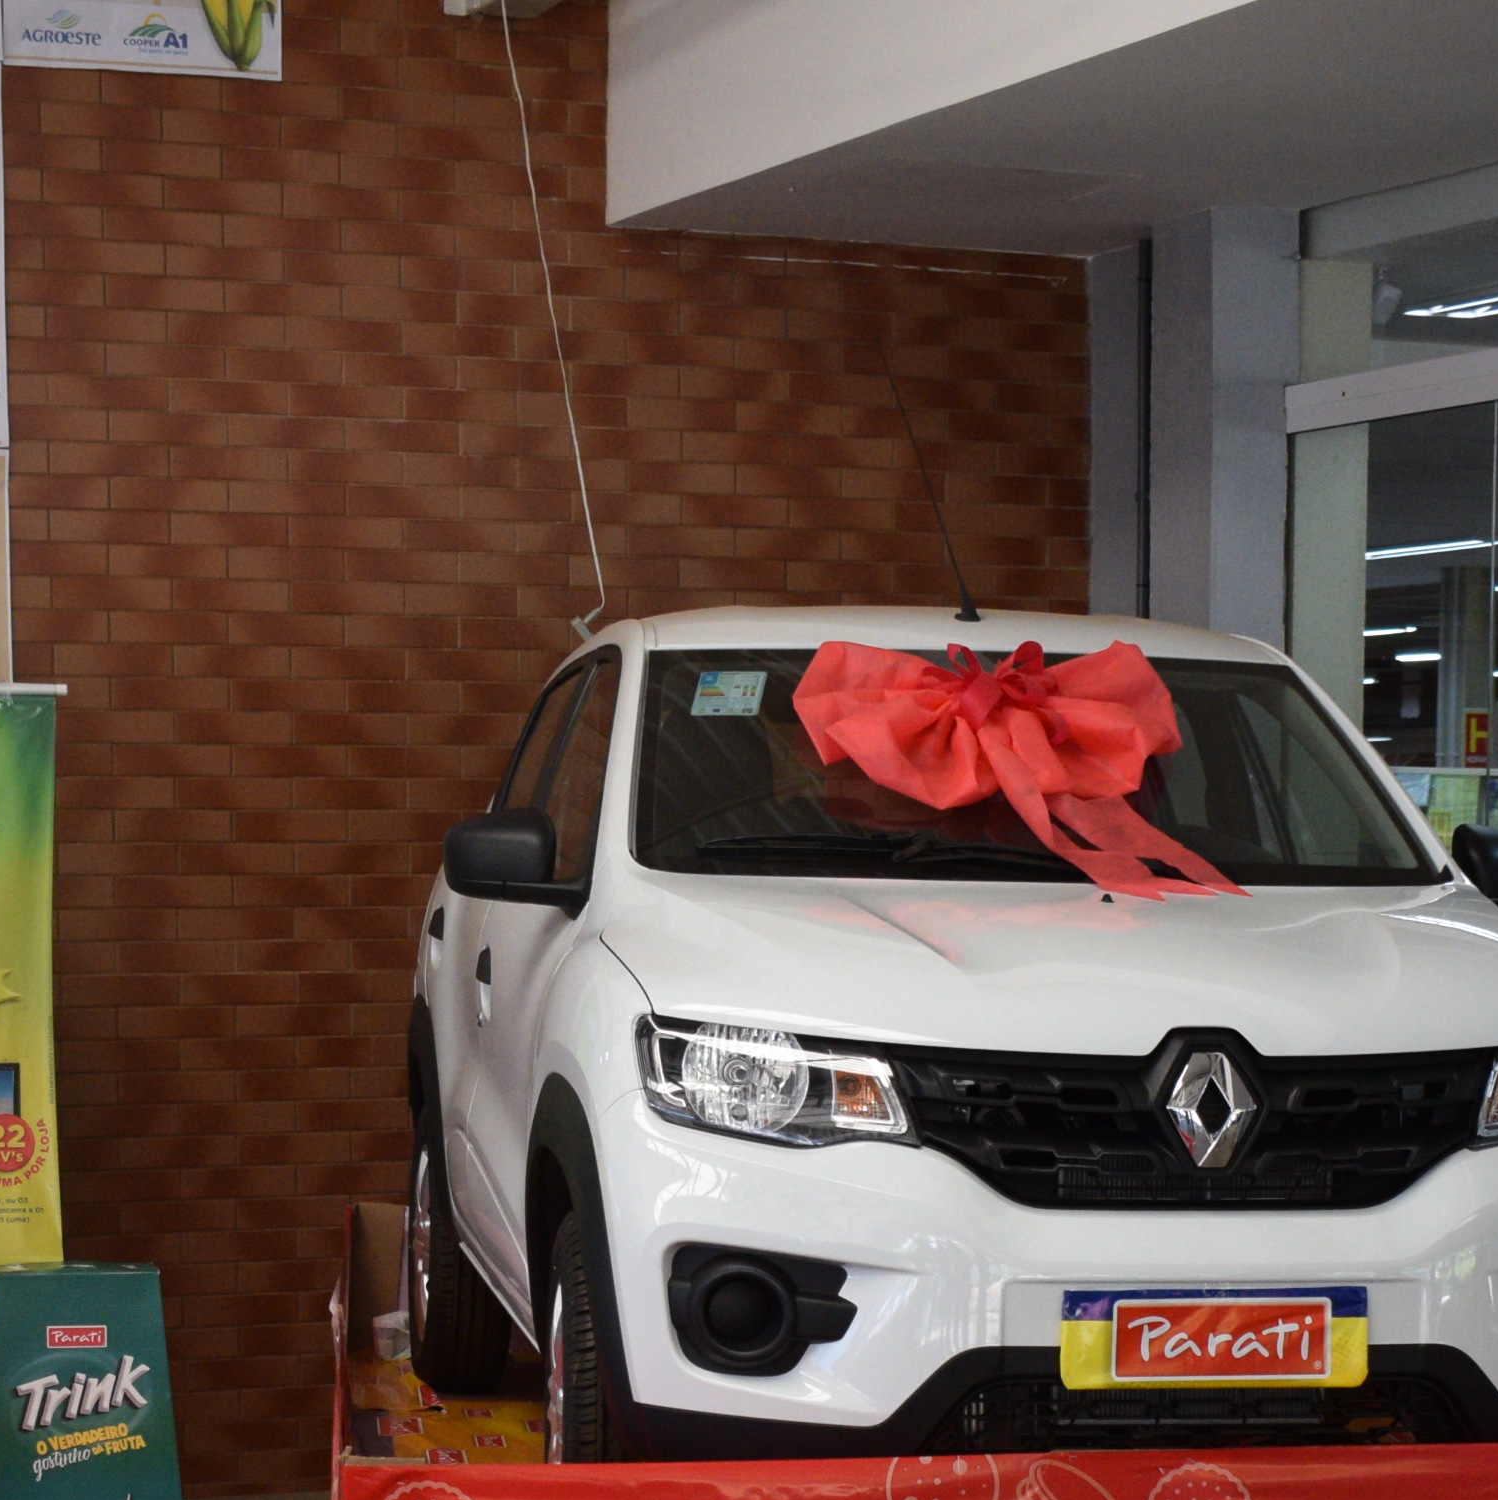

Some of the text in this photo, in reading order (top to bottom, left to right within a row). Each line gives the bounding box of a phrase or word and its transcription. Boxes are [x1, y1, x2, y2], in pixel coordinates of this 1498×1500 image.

[23, 1156, 46, 1180] POR
[36, 1118, 50, 1154] LOJA
[52, 1331, 101, 1342] Parati
[1127, 1316, 1313, 1361] Parati
[17, 1355, 150, 1430] Trink
[48, 1423, 128, 1451] VERDADEIRO
[105, 1435, 146, 1455] FRUTA
